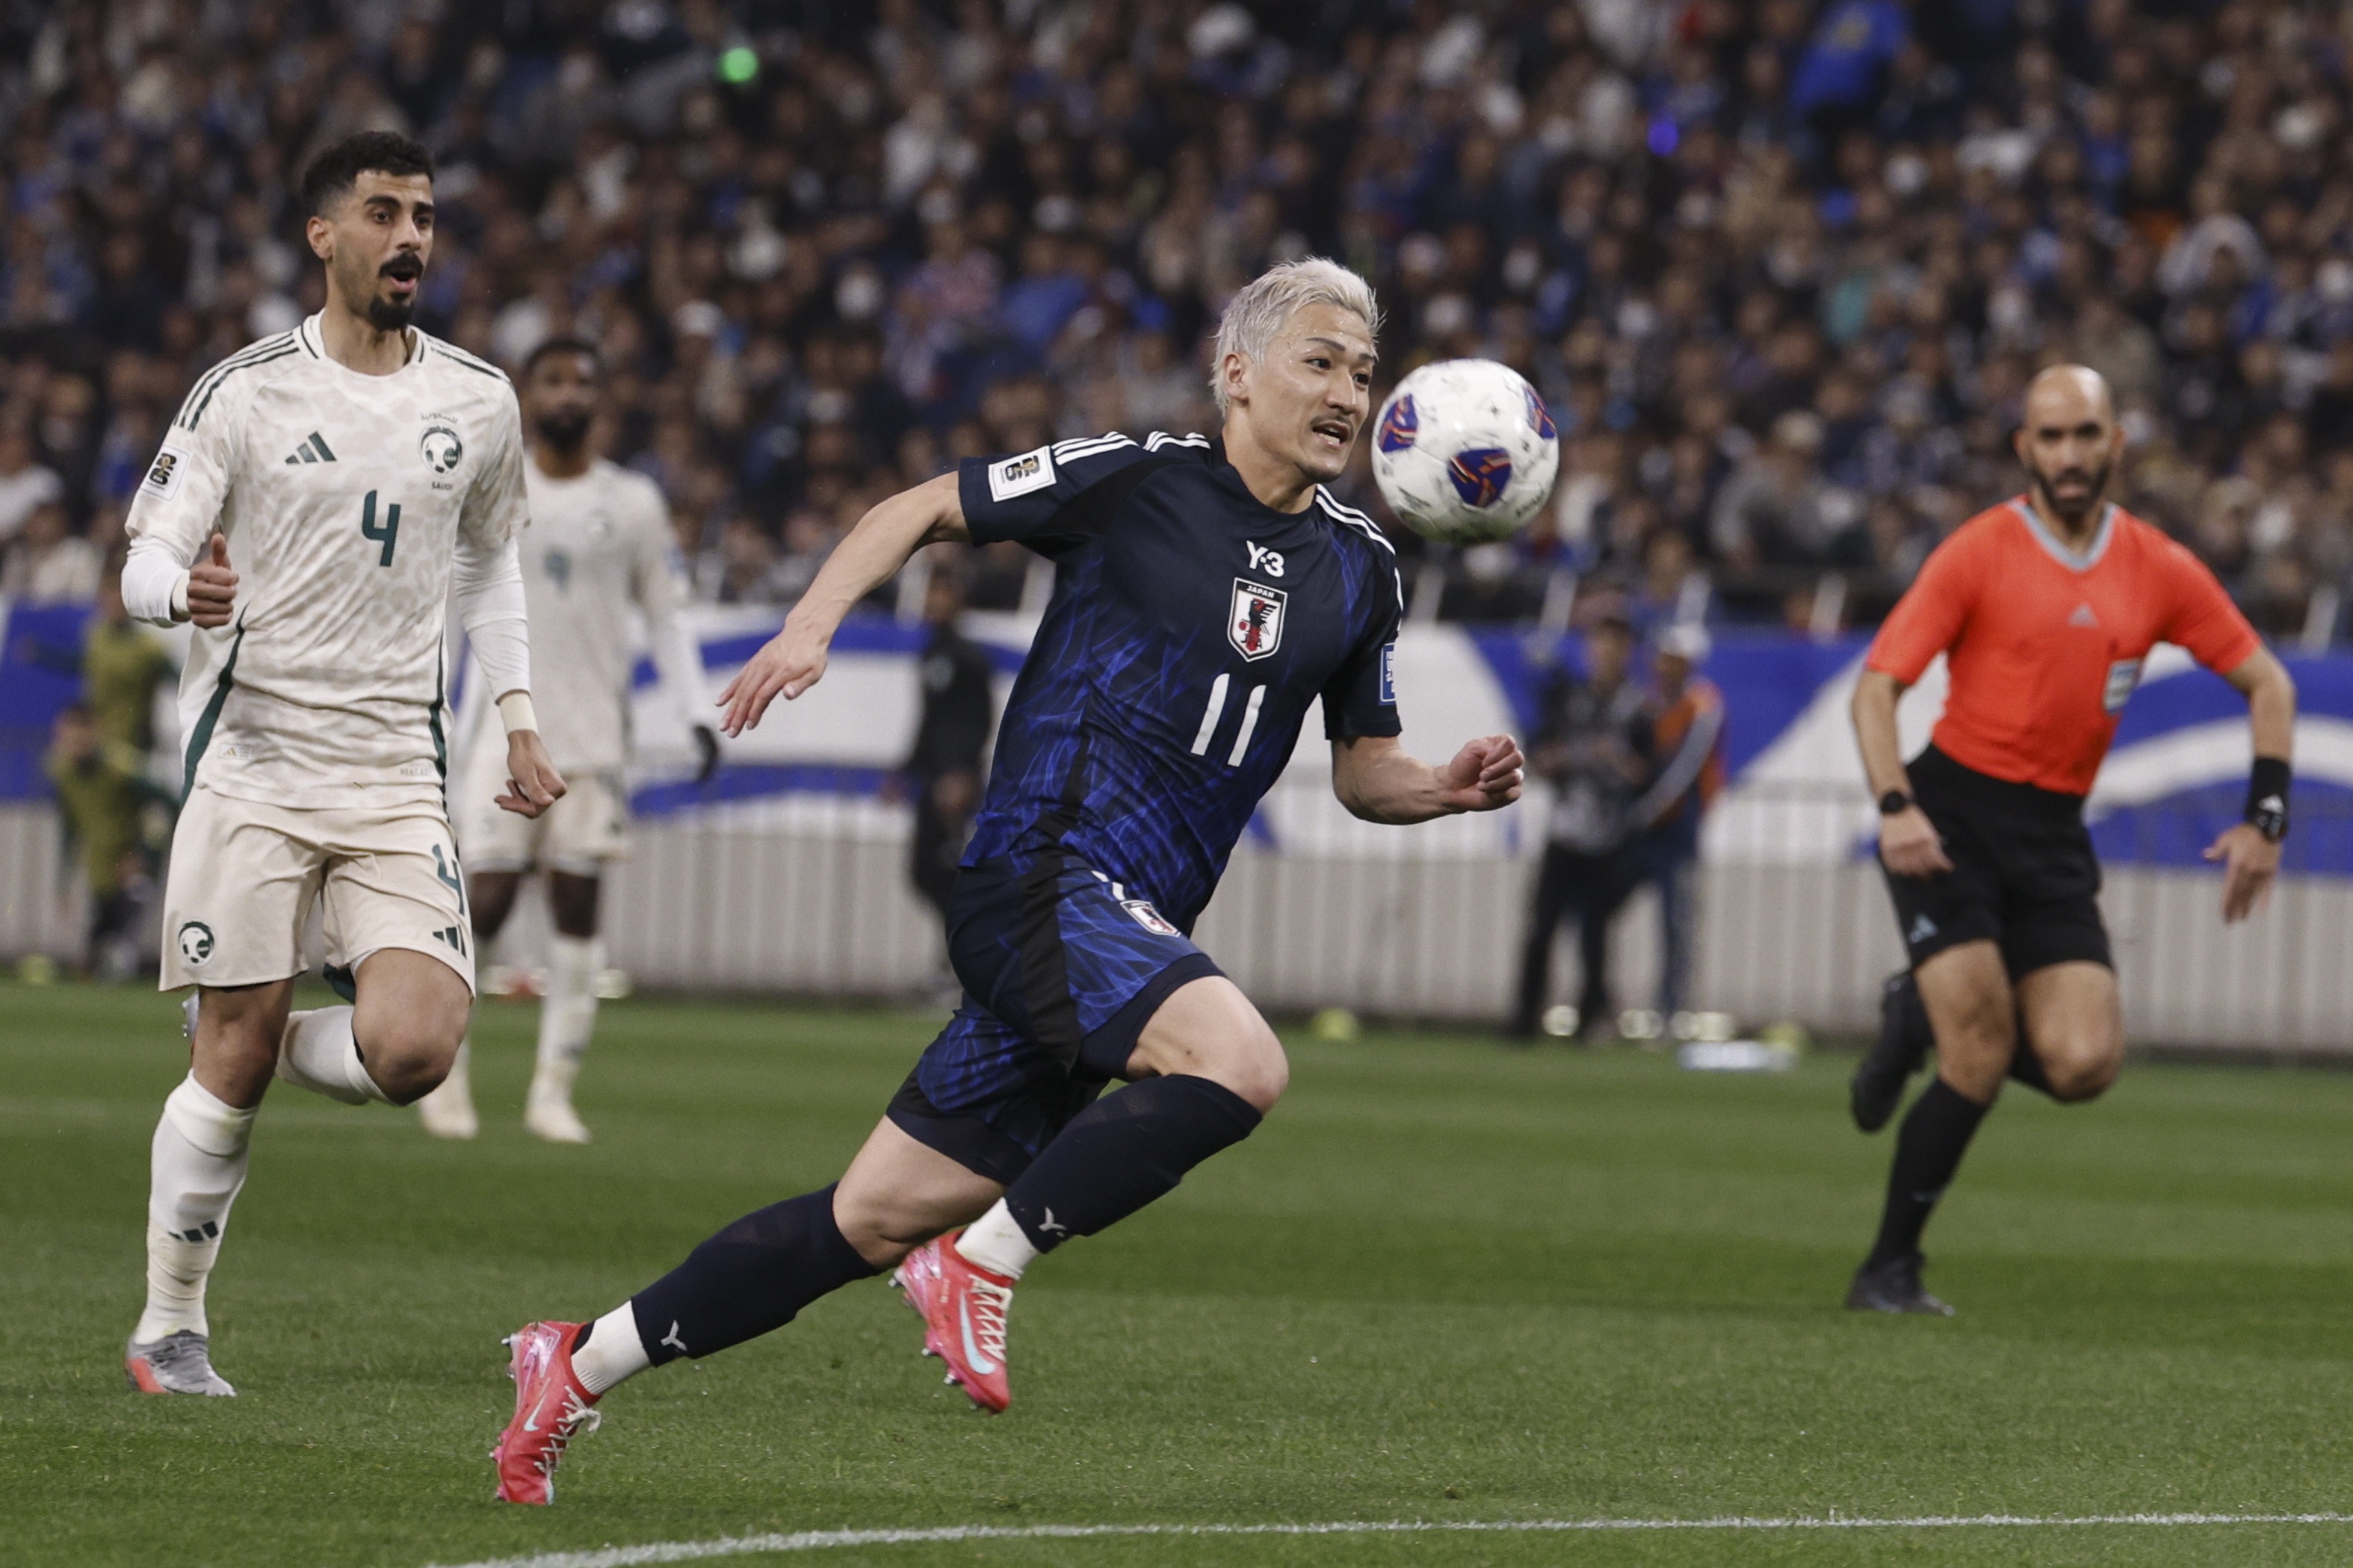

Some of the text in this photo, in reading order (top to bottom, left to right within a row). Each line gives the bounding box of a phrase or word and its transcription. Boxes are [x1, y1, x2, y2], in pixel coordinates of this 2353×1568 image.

[362, 490, 401, 567] 4
[1246, 540, 1284, 577] Y-3
[1246, 585, 1275, 598] JAPAN
[1190, 673, 1267, 767] 11
[432, 844, 464, 916] 4
